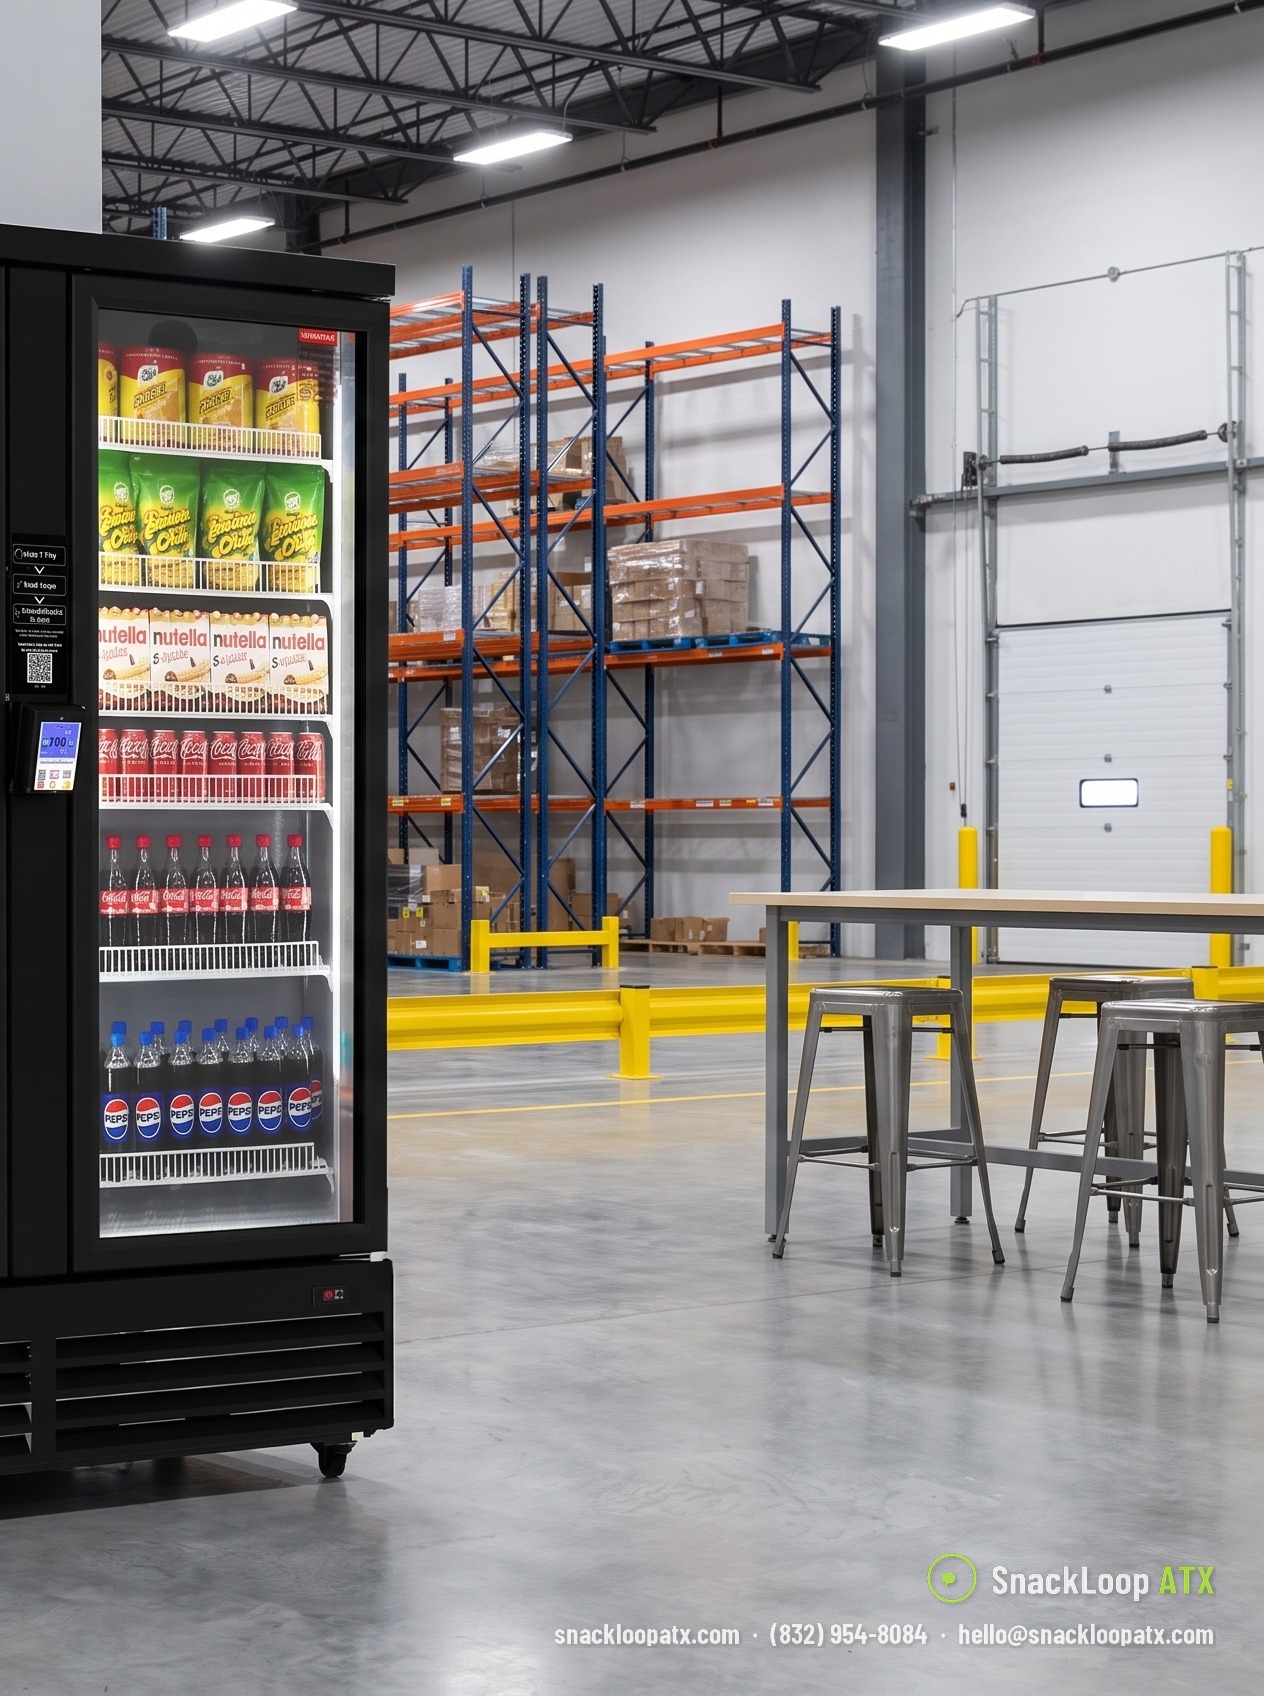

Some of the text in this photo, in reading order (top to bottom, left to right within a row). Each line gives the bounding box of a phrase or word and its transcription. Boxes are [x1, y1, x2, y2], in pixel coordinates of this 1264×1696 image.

[98, 626, 147, 645] nutella
[153, 629, 207, 647] nutella
[213, 631, 267, 649] nutella
[272, 633, 325, 650] nutella
[228, 1106, 251, 1116] PEPS
